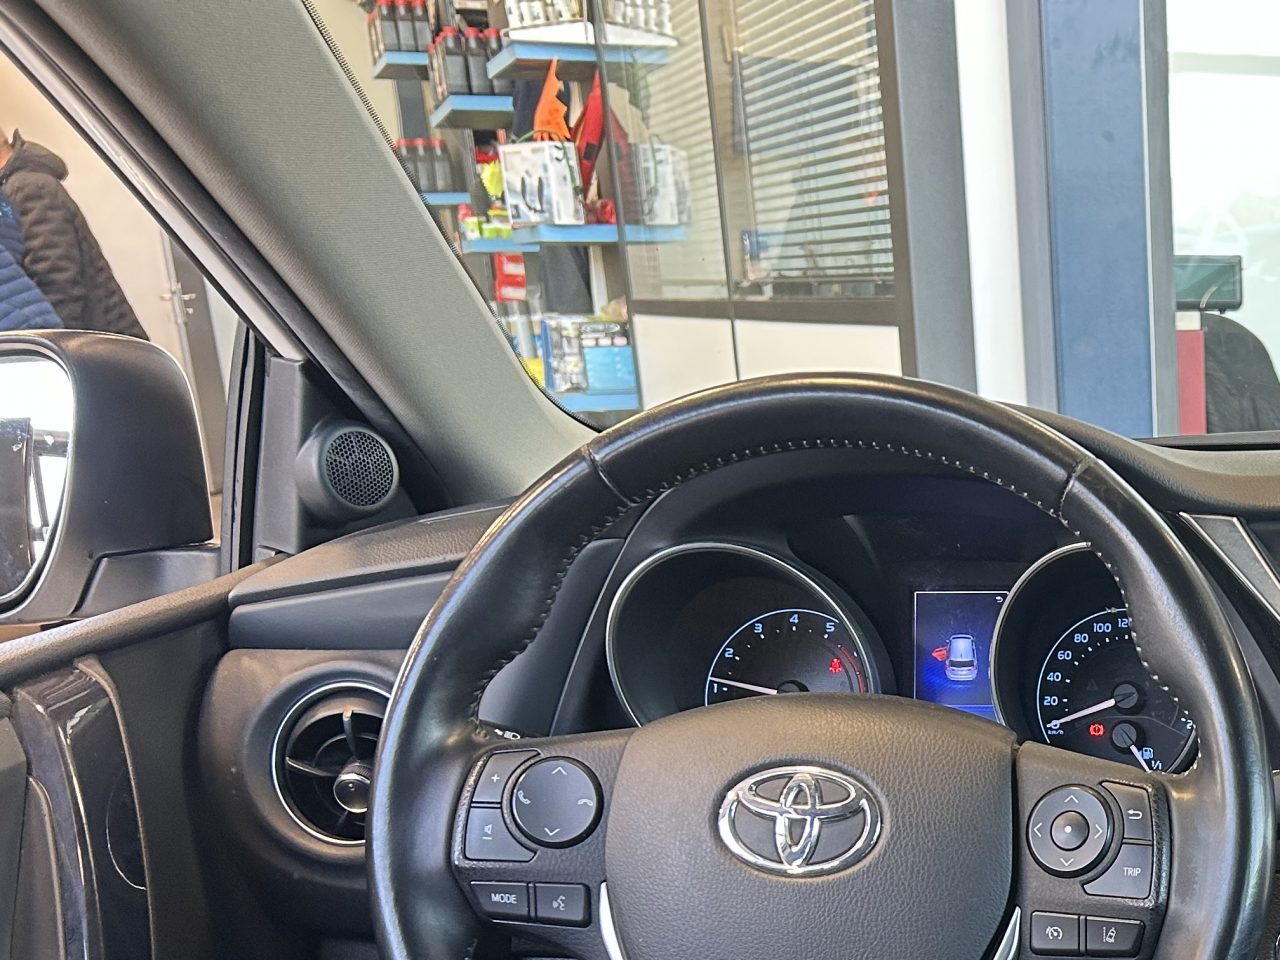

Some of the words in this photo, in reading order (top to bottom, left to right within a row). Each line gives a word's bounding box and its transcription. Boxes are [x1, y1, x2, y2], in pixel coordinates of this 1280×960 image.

[789, 613, 799, 623] 4
[754, 623, 763, 633] 3
[825, 622, 835, 632] 5
[1093, 623, 1112, 632] 100
[1074, 633, 1089, 643] 80
[724, 648, 734, 658] 2
[1057, 651, 1072, 660] 60
[1046, 672, 1061, 682] 40
[712, 683, 718, 694] 1
[1043, 696, 1058, 706] 20
[1123, 866, 1142, 877] TRIP
[491, 893, 518, 904] MODE
